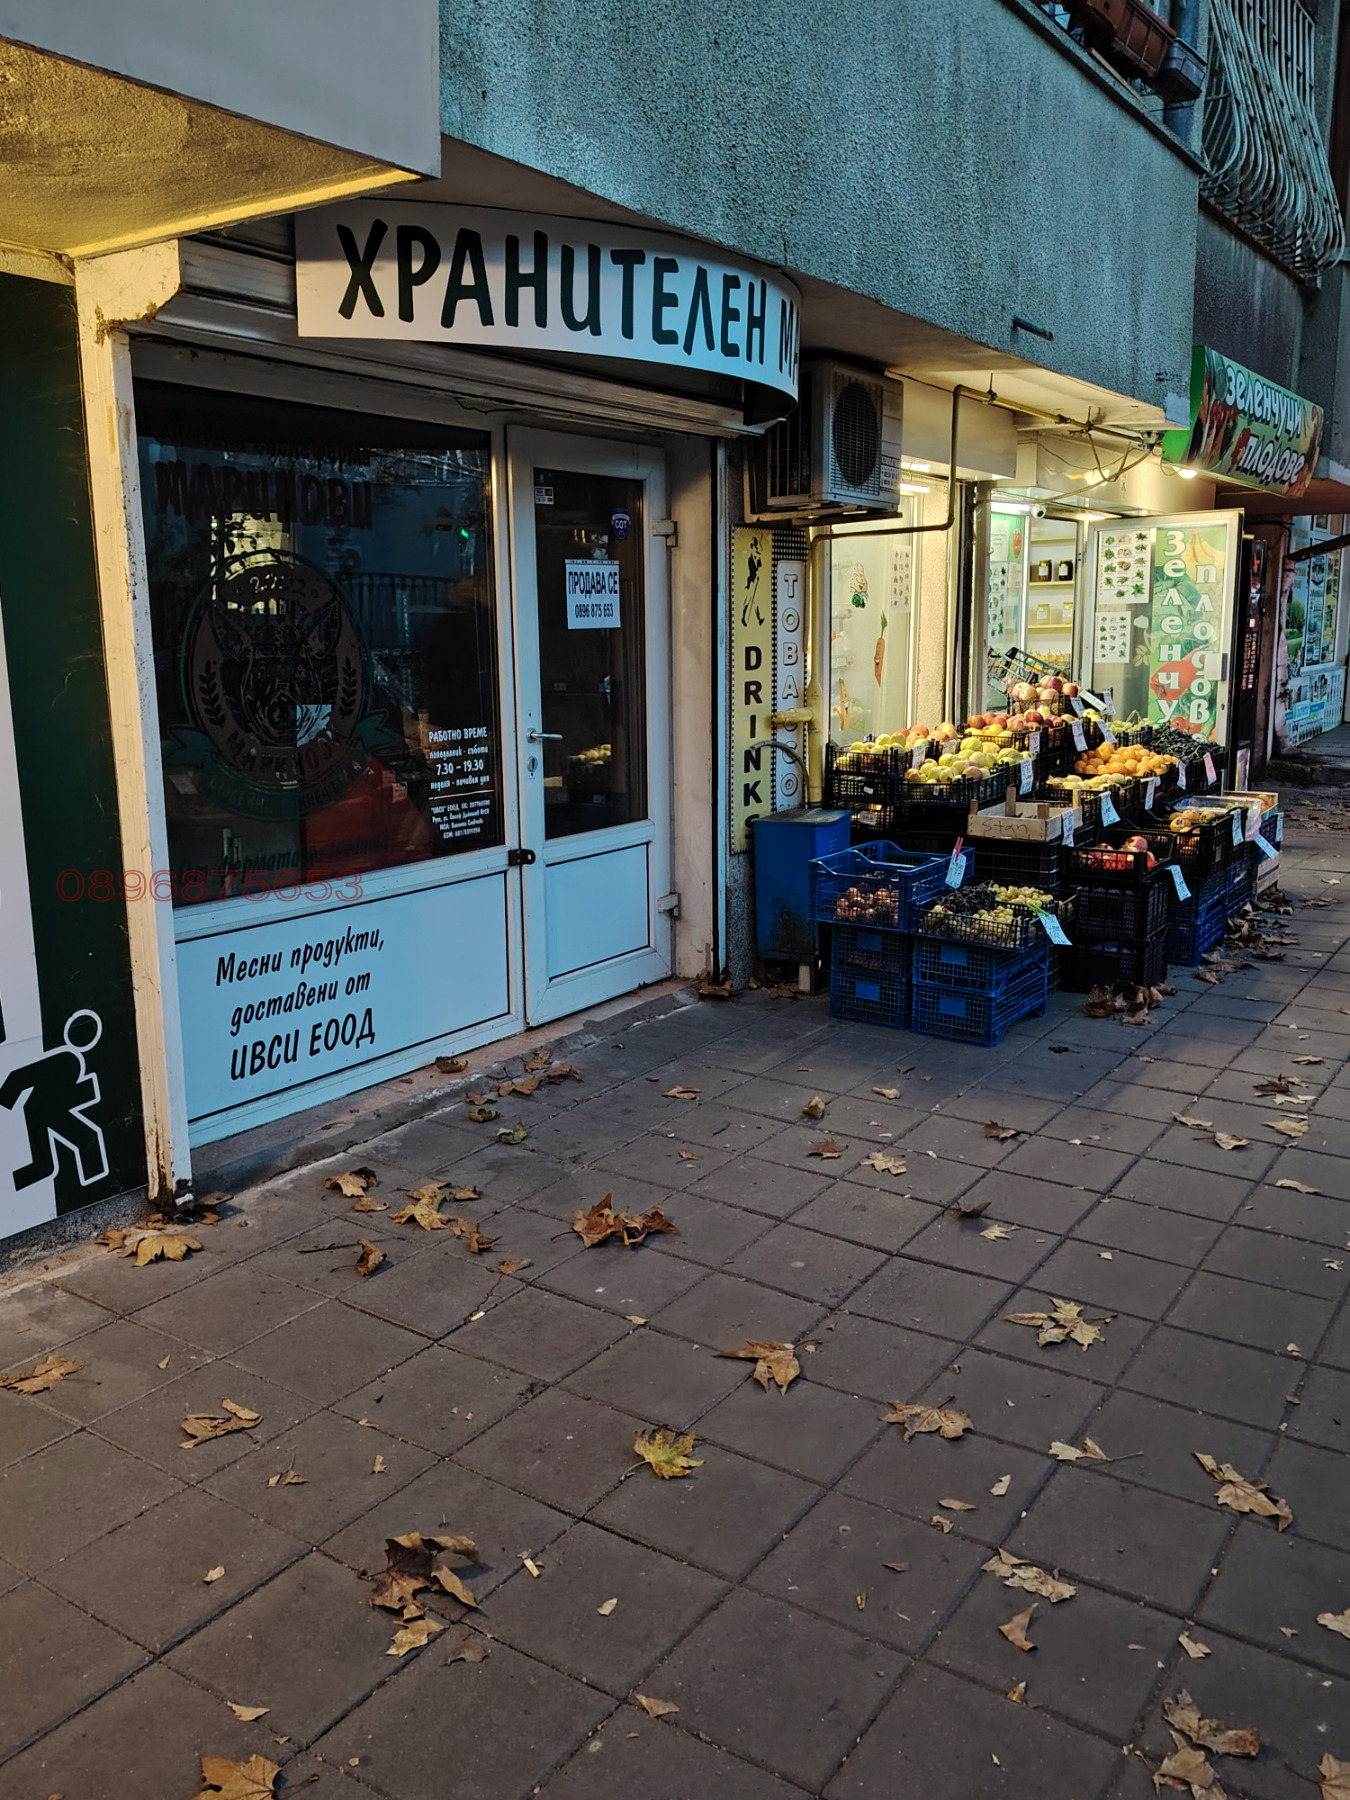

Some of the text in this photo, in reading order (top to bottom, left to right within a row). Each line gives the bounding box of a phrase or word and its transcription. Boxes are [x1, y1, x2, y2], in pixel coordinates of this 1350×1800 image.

[336, 218, 768, 365] ХРАНИТЕЛЕН
[568, 571, 618, 599] ПРОДАВА СЕ
[575, 604, 614, 618] 0896 875 653
[428, 727, 487, 742] РАБОТНО ВРЕМЕ
[430, 746, 462, 760] понеделник
[436, 763, 454, 775] 7.30
[463, 759, 484, 772] 19.30
[216, 925, 385, 986] Месни продукти,
[230, 972, 371, 1037] доставени от
[230, 1007, 376, 1081] ИВСИ ЕООД
